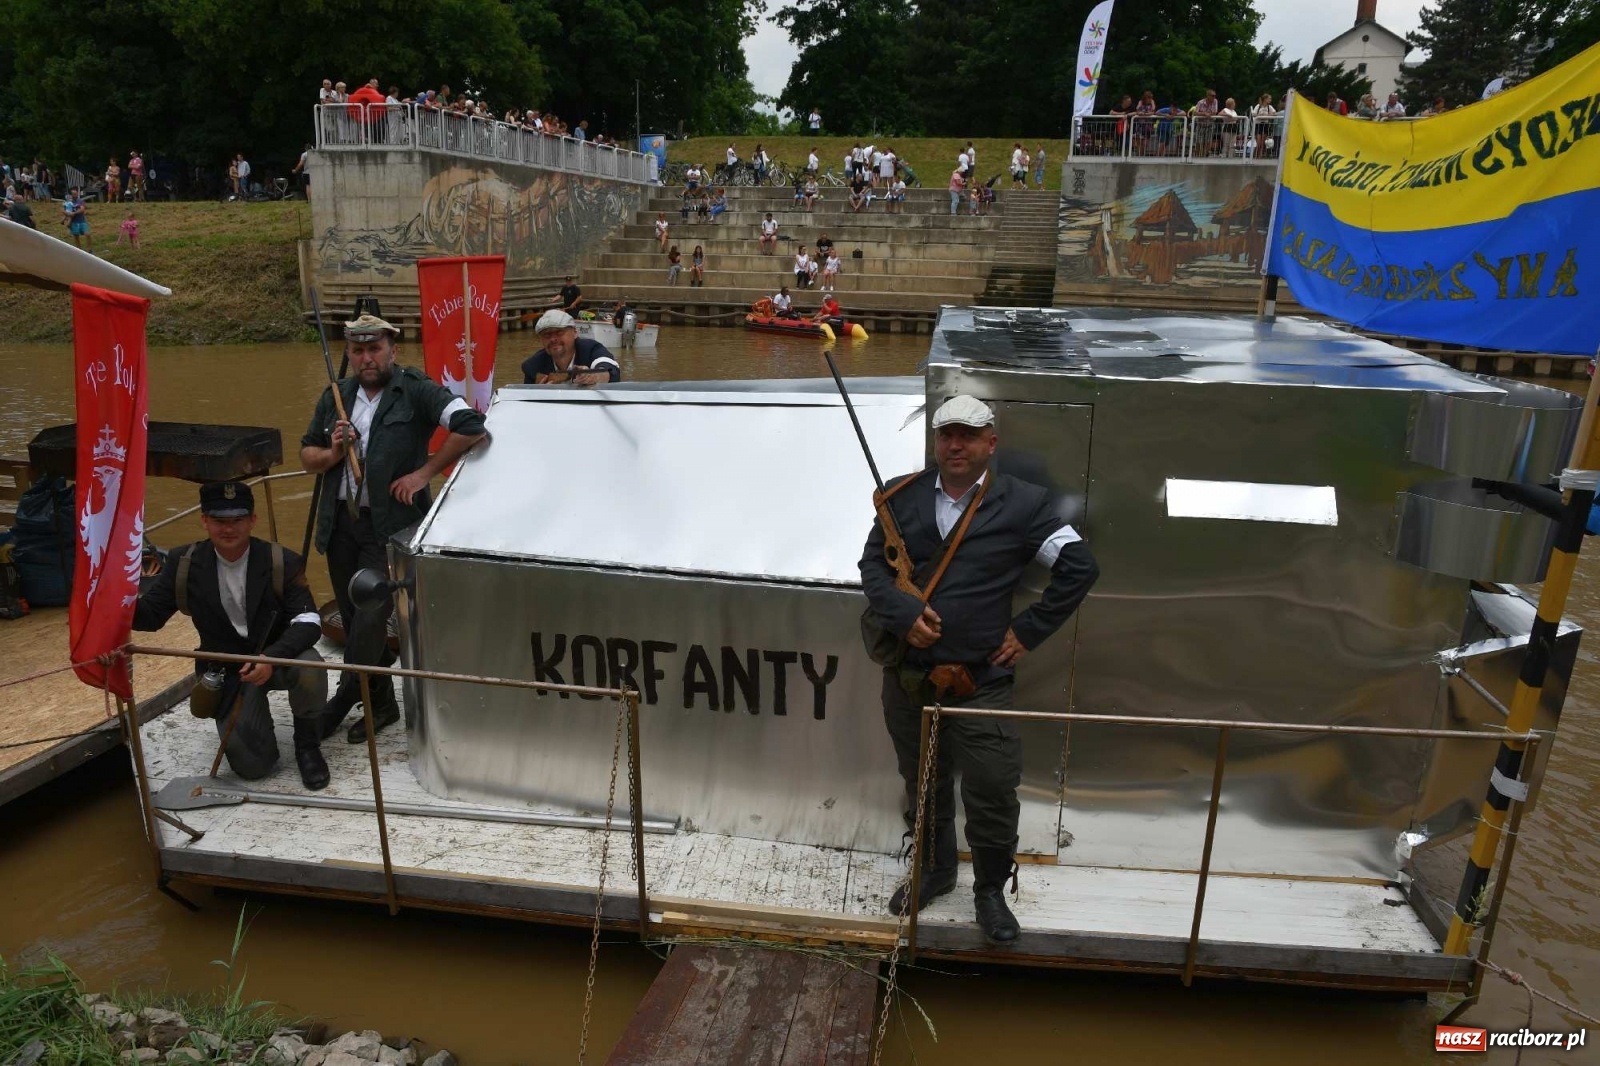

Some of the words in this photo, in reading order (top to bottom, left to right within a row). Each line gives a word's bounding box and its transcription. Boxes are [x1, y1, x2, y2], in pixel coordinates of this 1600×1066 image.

[428, 295, 464, 327] Tobie
[467, 284, 499, 325] Polsk
[531, 632, 839, 720] KORFANTY
